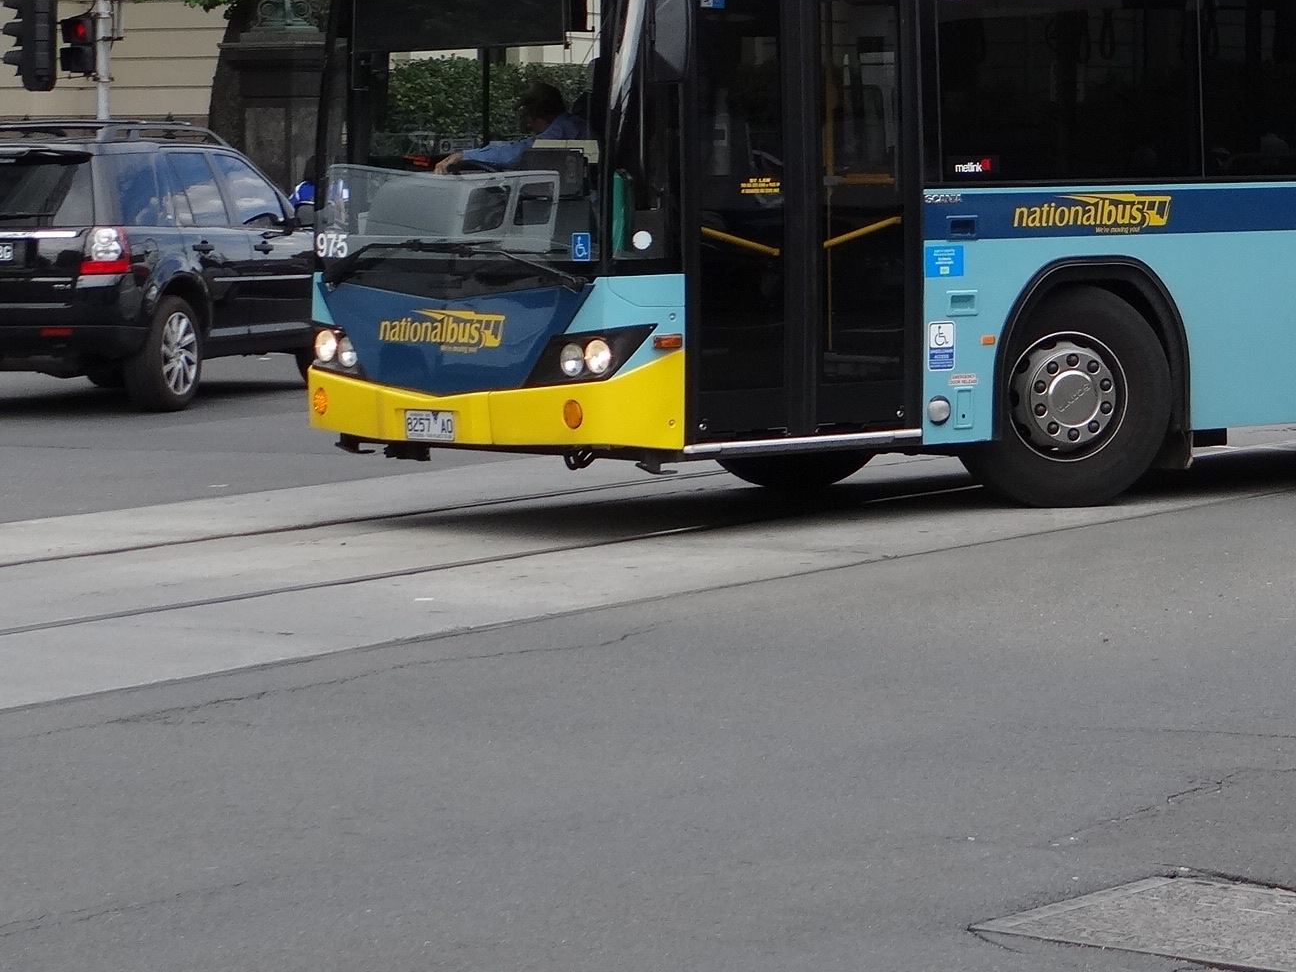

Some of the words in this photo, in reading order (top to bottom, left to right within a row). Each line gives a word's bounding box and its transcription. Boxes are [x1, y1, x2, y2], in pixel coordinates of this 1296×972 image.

[1013, 199, 1143, 227] nationalbus
[317, 233, 348, 258] 975
[378, 316, 480, 344] nationalbus
